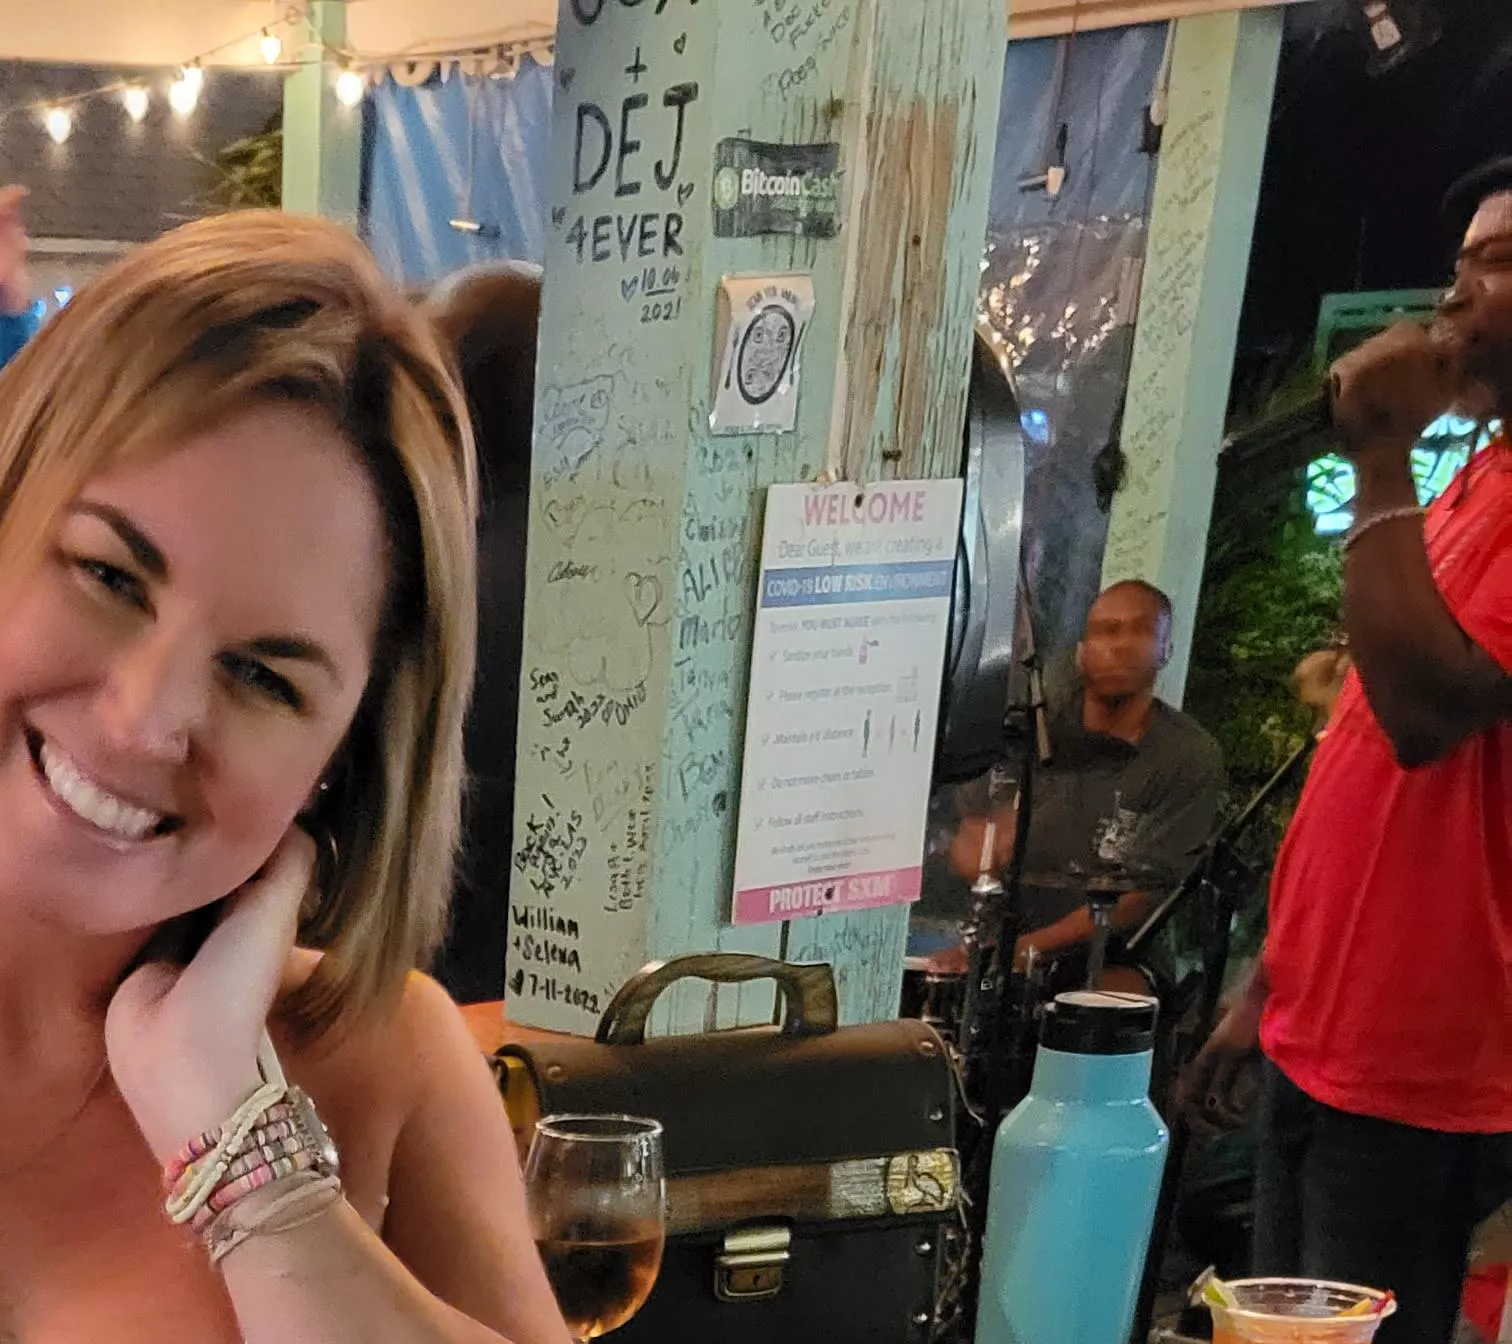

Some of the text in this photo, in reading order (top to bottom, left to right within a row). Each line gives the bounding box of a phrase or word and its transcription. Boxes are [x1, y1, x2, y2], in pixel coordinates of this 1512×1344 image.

[572, 81, 699, 198] DEJ
[566, 212, 684, 265] 4EVER
[803, 490, 927, 527] WELCOME
[767, 576, 814, 597] COVID-19
[815, 574, 842, 595] LOW
[845, 573, 872, 593] RISK
[769, 877, 844, 914] PROTECT
[511, 904, 580, 941] William
